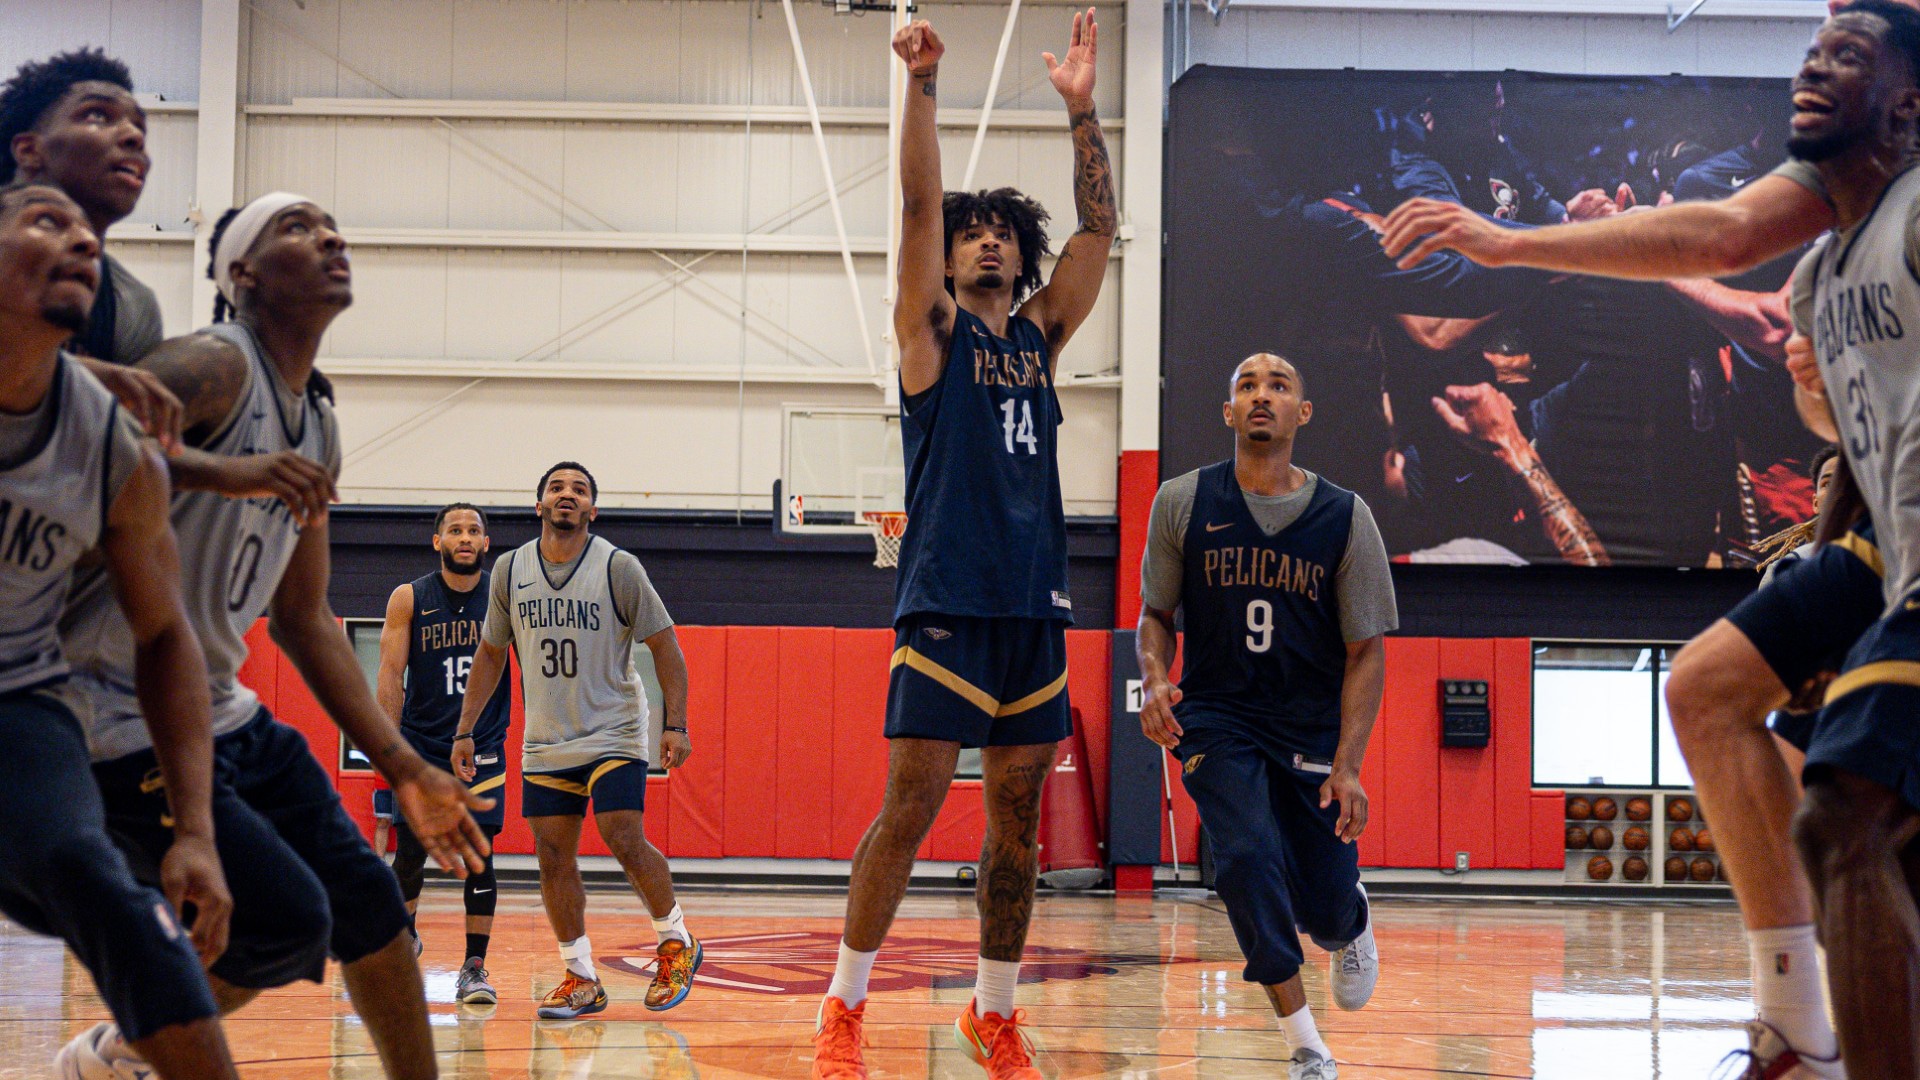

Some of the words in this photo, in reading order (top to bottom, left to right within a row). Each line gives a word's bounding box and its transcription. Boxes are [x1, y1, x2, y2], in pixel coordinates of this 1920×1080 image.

[1000, 398, 1037, 454] 14
[228, 534, 264, 611] 0
[1204, 546, 1324, 601] PELICANS
[518, 597, 600, 631] PELICANS
[1246, 598, 1274, 653] 9
[443, 656, 473, 695] 15
[540, 638, 578, 678] 30
